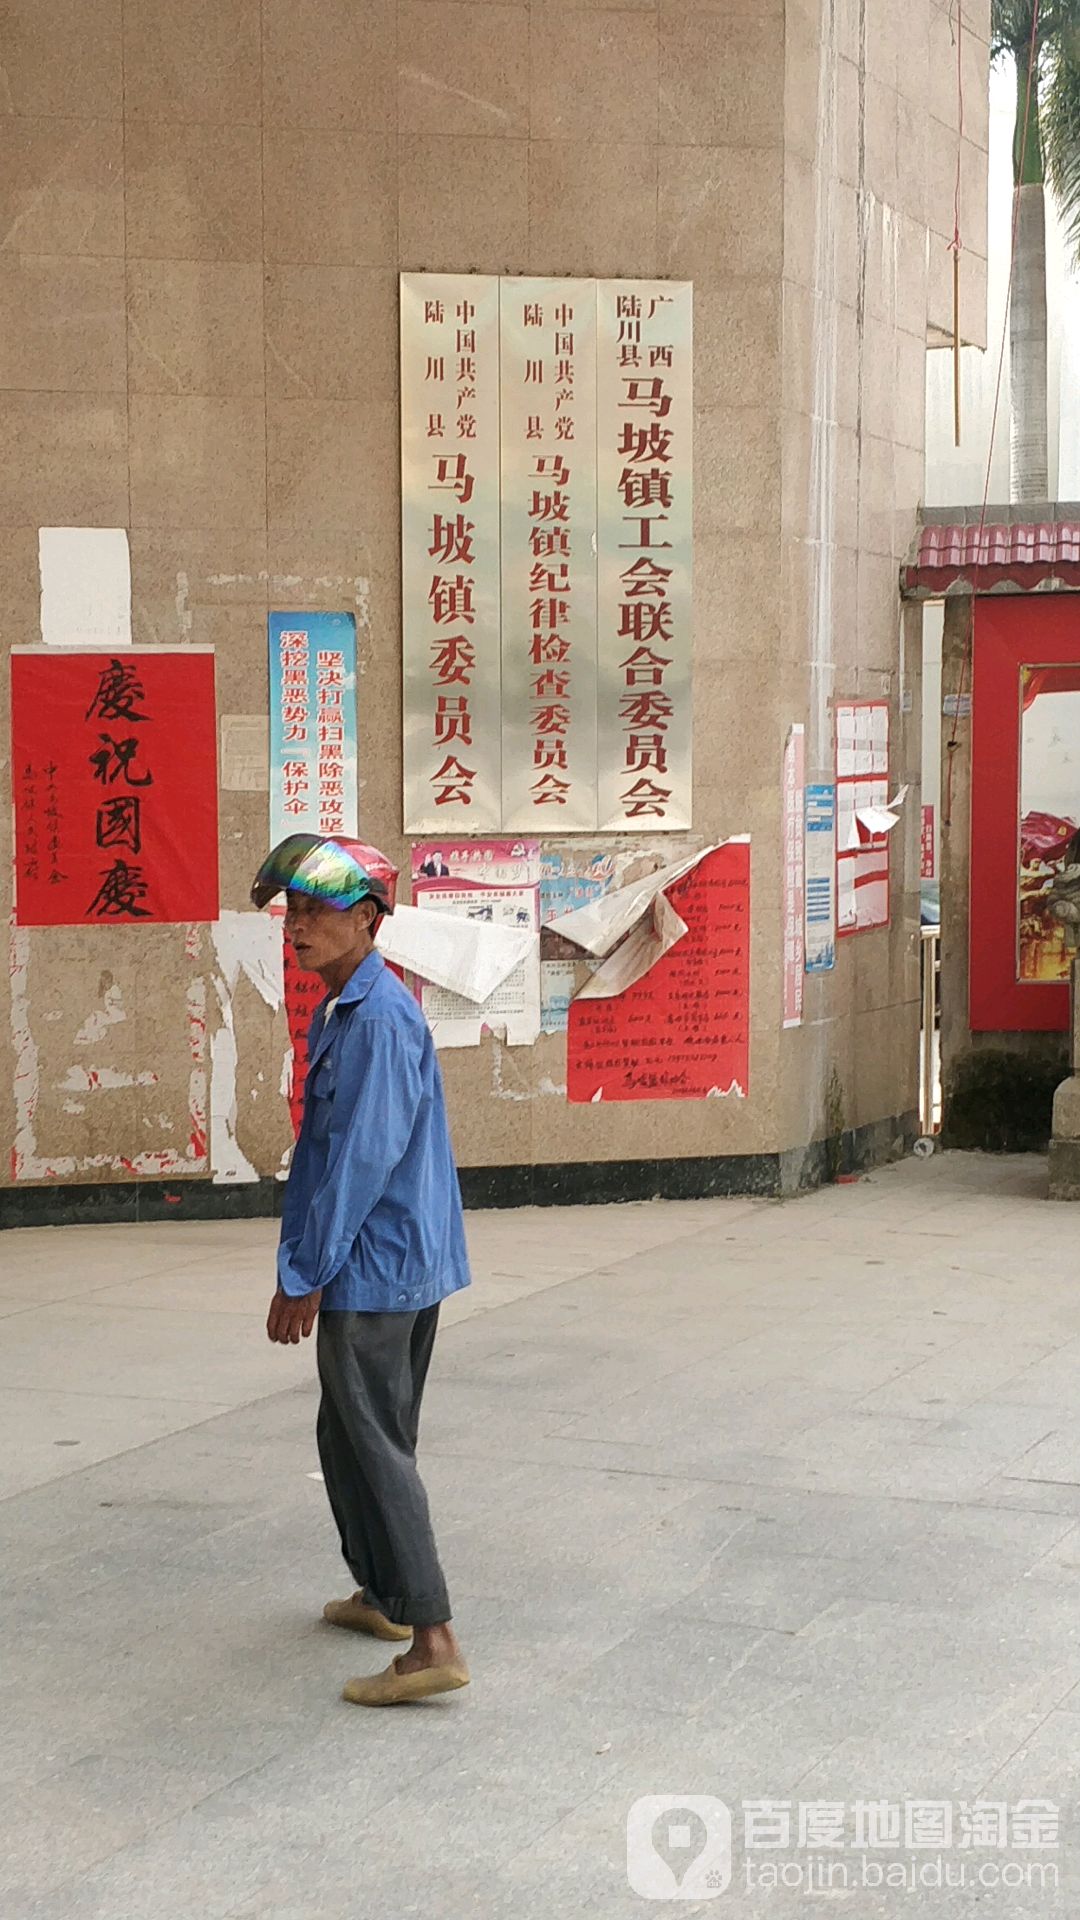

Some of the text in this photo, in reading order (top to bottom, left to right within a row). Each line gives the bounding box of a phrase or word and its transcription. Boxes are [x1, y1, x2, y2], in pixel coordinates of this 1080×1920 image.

[424, 300, 445, 439] 陆川县
[455, 300, 477, 440] 中国共产党
[523, 303, 544, 440] 陆川县
[554, 303, 575, 441] 中国共产党
[615, 295, 643, 369] 陆川县
[647, 295, 674, 369] 广西
[427, 452, 477, 807] 马坡镇委员会
[527, 454, 573, 806] 马坡镇纪律检查委员会
[616, 376, 674, 819] 马坡镇工会联合委员会
[316, 651, 346, 834] 坚决打赢扫黑除恶攻坚
